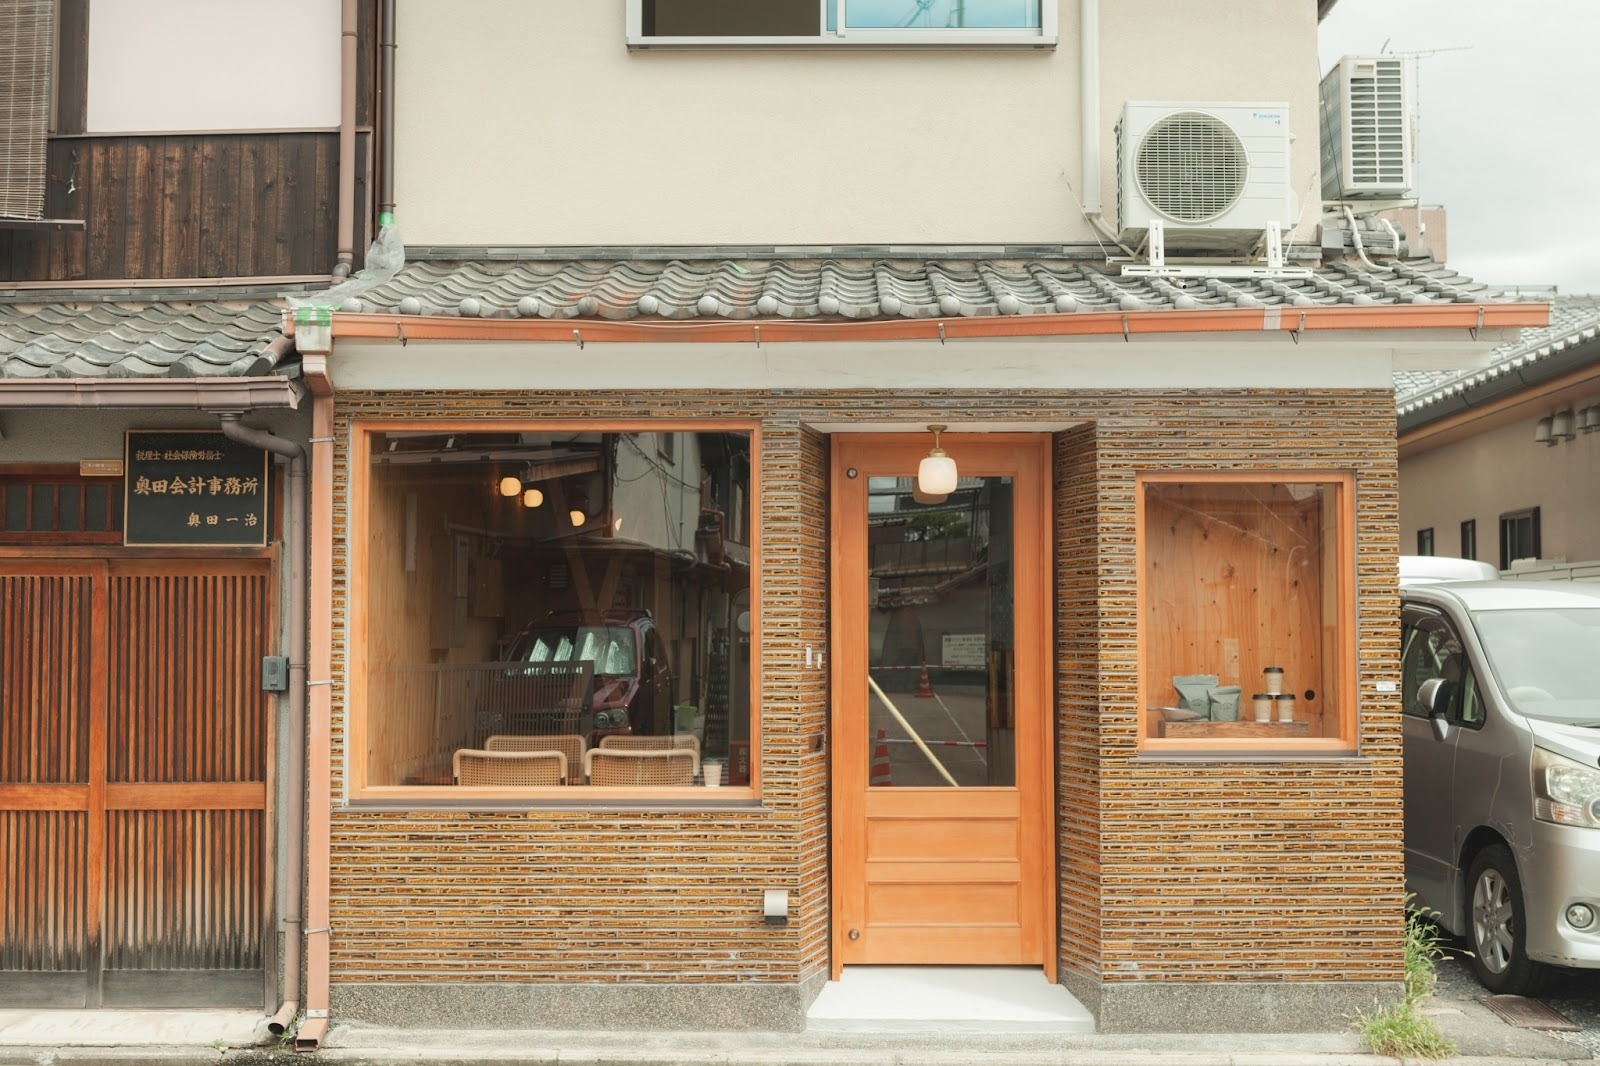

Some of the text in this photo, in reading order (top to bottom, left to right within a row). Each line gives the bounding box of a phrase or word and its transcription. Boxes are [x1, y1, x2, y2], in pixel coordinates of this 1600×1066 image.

[133, 475, 258, 496] 奥田会計事務所
